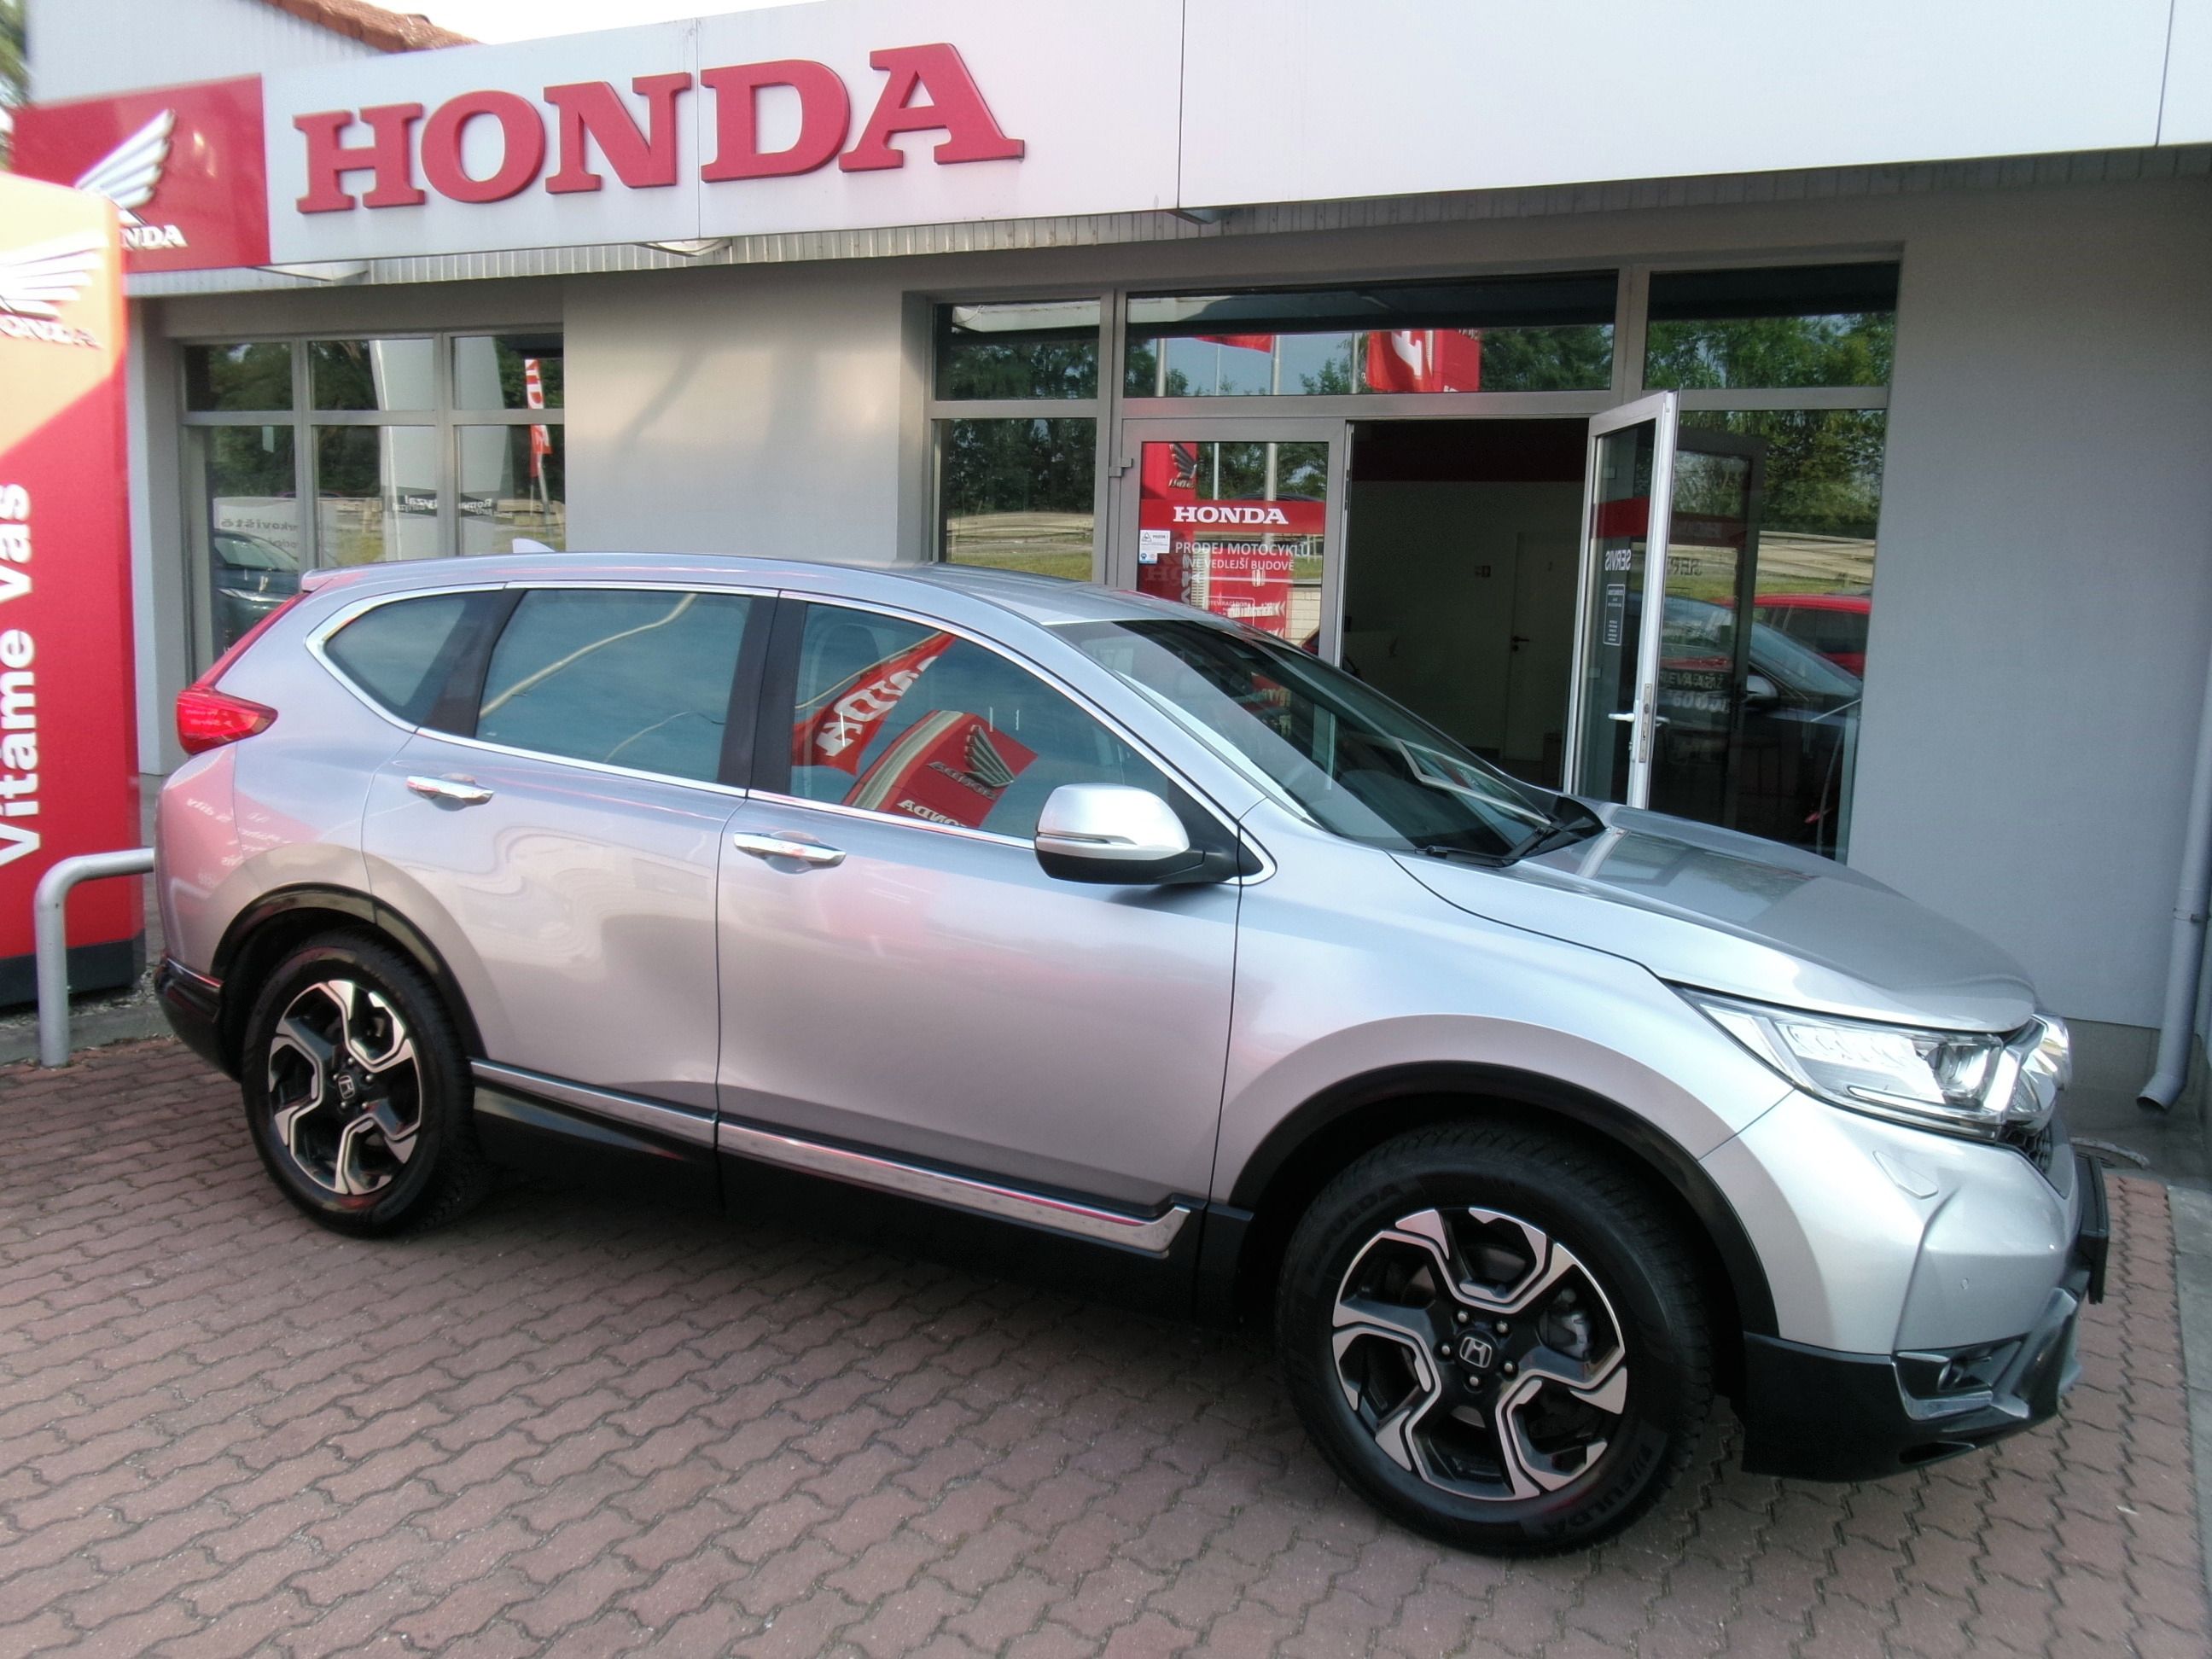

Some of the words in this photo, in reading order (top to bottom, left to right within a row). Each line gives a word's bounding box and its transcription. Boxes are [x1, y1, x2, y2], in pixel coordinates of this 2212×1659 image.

[294, 43, 1026, 214] HONDA
[119, 224, 189, 251] NDA
[1173, 506, 1289, 524] HONDA
[1175, 541, 1223, 555] PRODEJ
[1227, 540, 1310, 556] MOTOCYKLŮ
[1190, 559, 1202, 568] VE
[1204, 556, 1249, 569] VEDLEJŠÍ
[1251, 559, 1295, 571] BUDOVĚ
